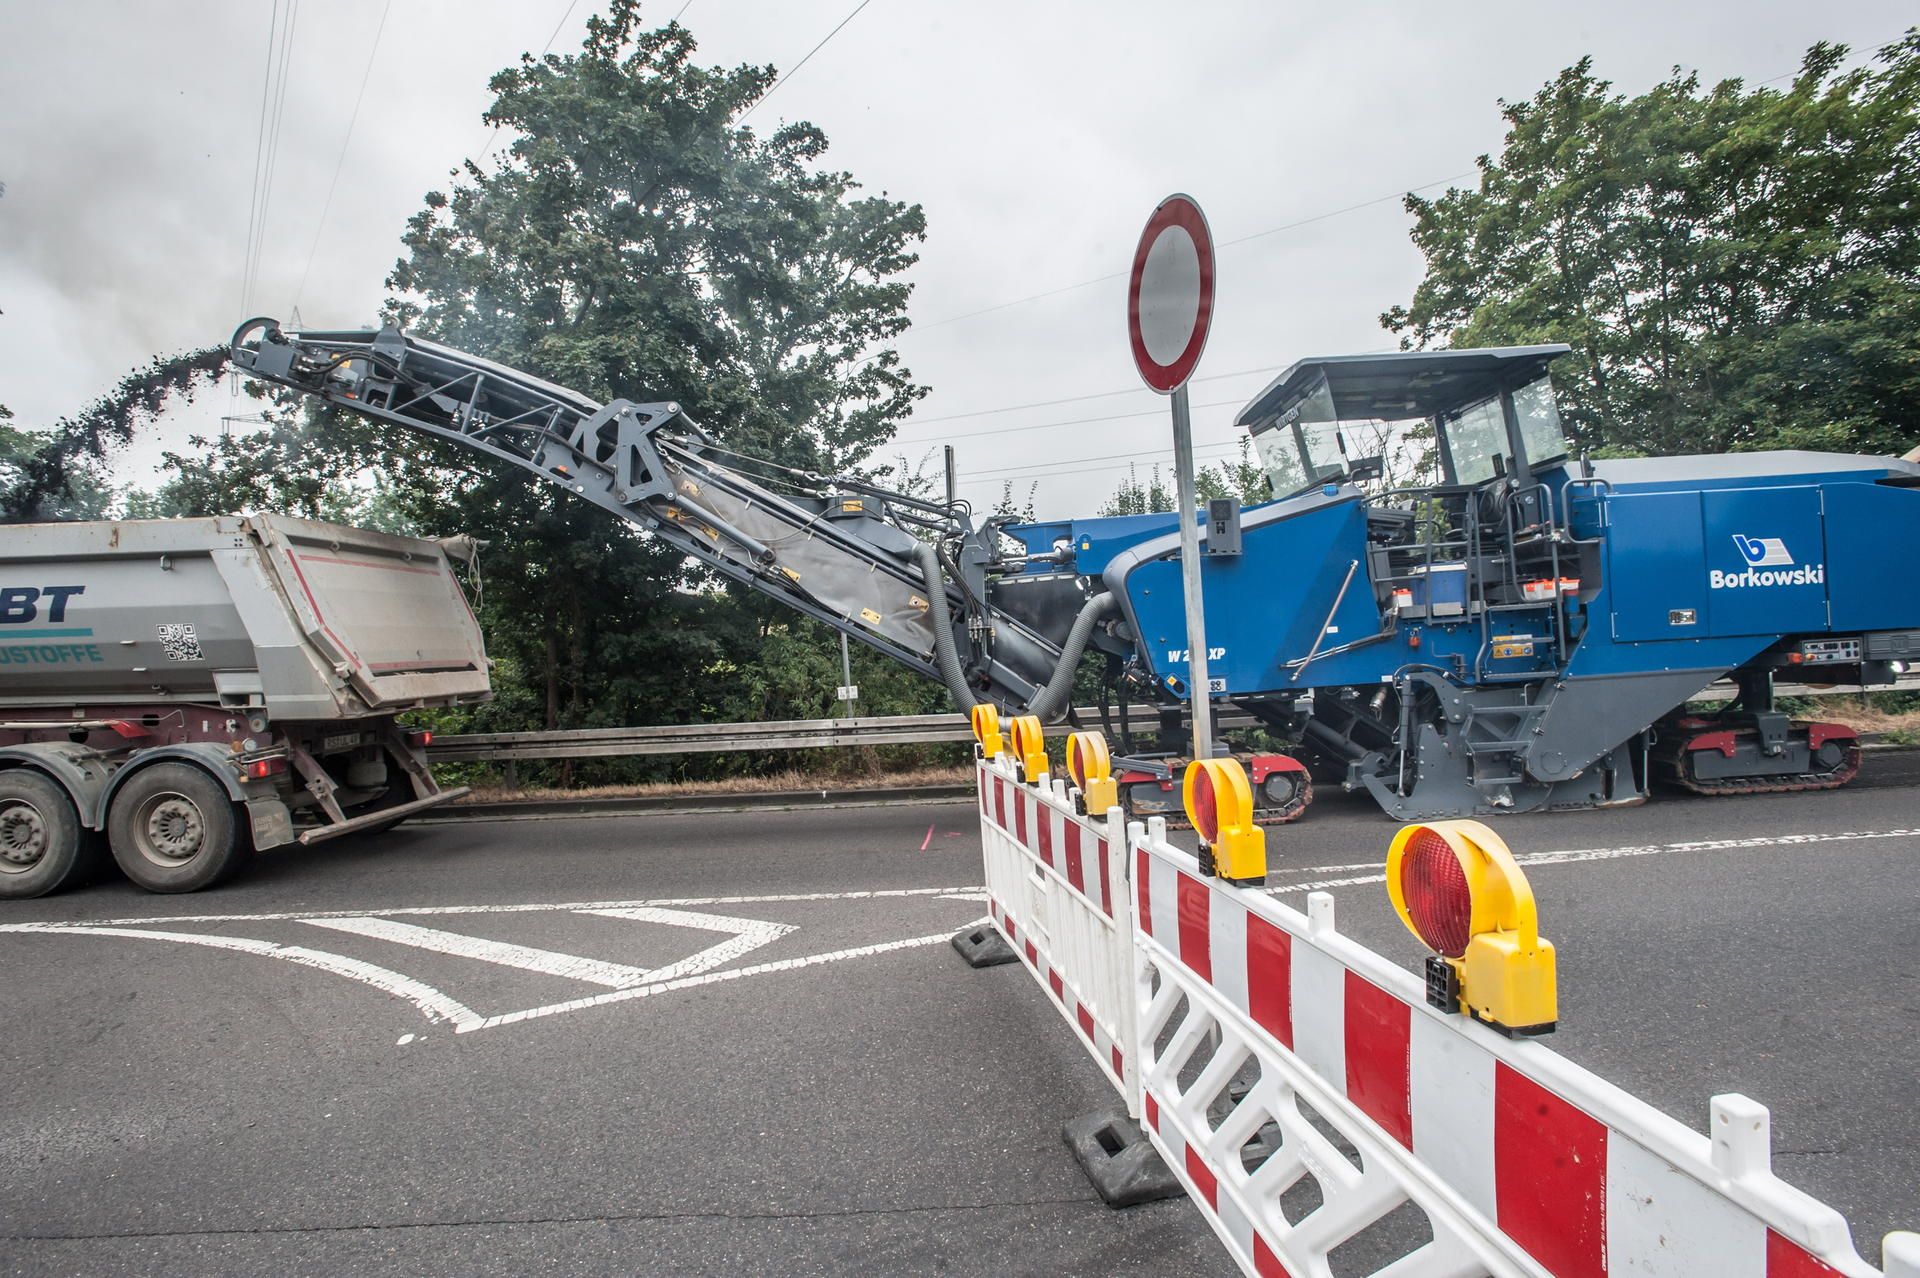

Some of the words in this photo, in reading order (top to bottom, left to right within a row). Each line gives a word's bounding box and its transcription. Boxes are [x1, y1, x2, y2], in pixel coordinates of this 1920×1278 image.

[1710, 564, 1824, 589] Borkowski
[0, 585, 86, 624] BT
[1168, 650, 1181, 662] W
[1208, 647, 1226, 660] XP
